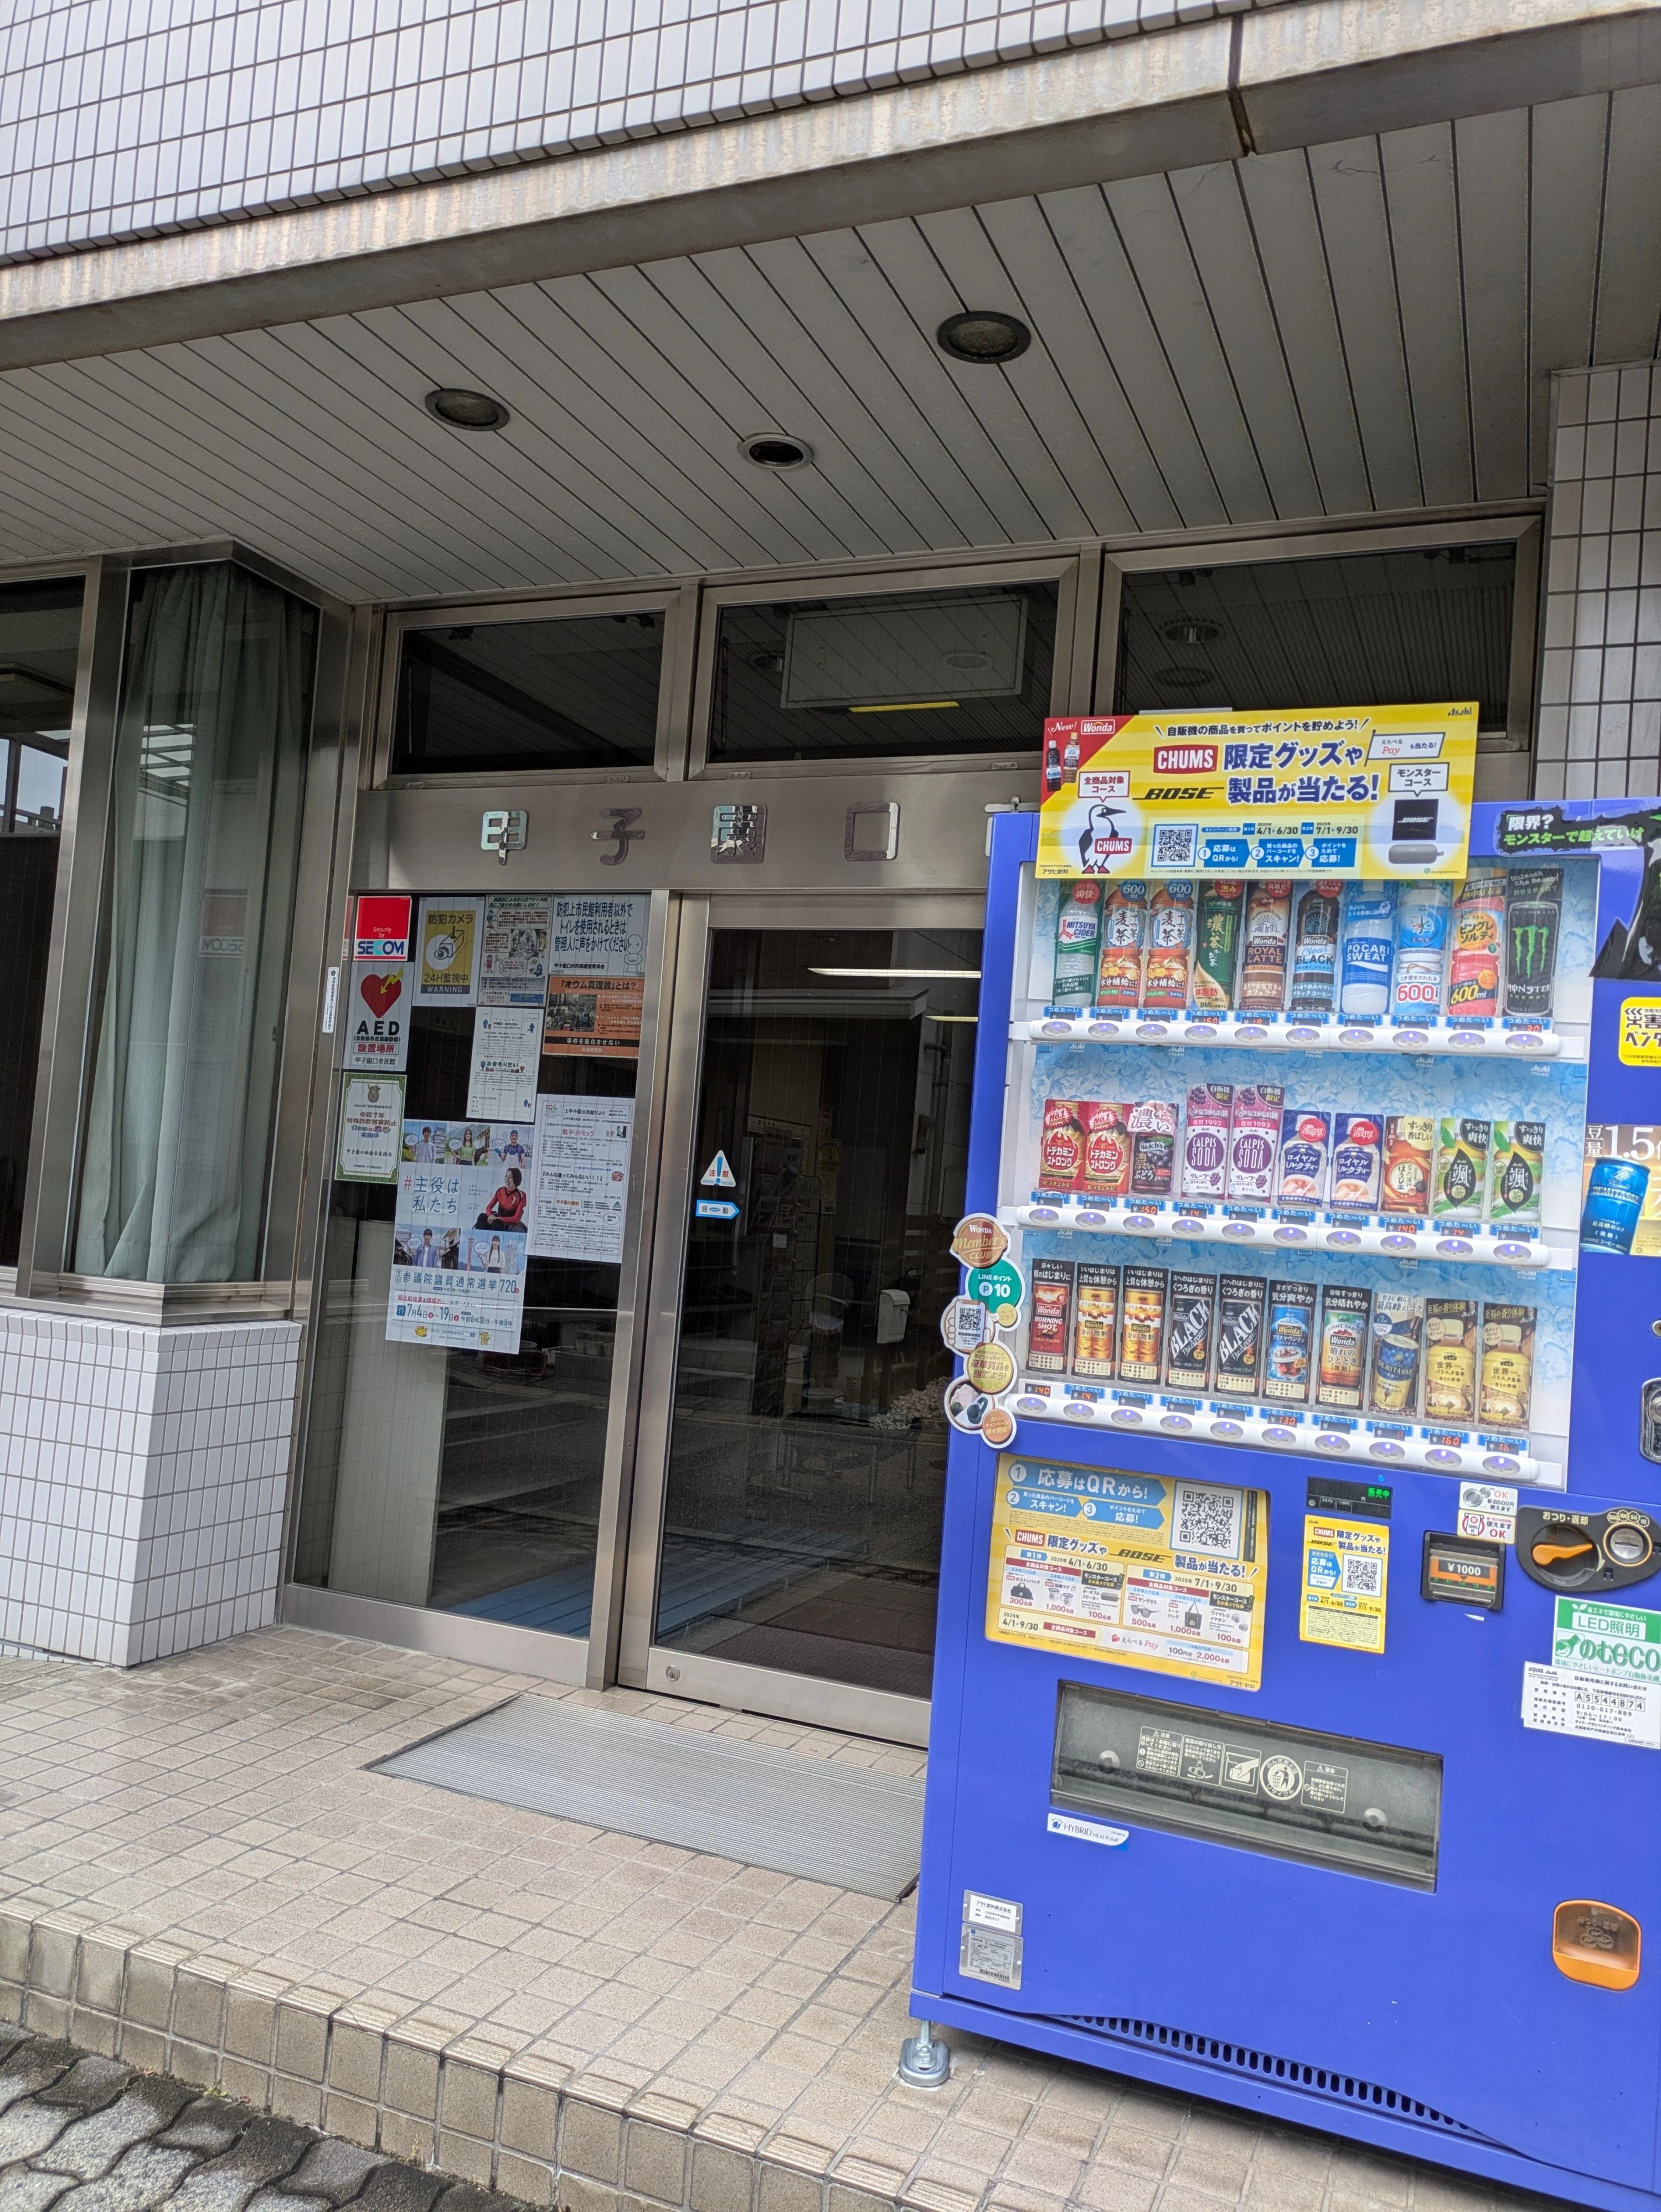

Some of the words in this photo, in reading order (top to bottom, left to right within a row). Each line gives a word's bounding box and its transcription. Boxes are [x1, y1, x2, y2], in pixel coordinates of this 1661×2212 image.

[1448, 707, 1472, 716] Asahi
[1168, 719, 1359, 737] 自販機の商品を買ってポイントを貯めよう!
[1158, 749, 1214, 769] CHUMS
[1224, 740, 1363, 770] 限定グッズや
[1382, 746, 1400, 755] Pay
[1084, 776, 1124, 785] 全商品対象
[1405, 778, 1431, 787] コース
[1133, 787, 1224, 800] BOSE
[1228, 775, 1379, 803] 製品が当たる!
[1508, 814, 1554, 831] 限界?
[1213, 844, 1236, 853] 応募は
[1510, 871, 1543, 881] Unleash
[1169, 884, 1190, 894] 600
[556, 902, 633, 917] 防犯上市民館利用者以外で
[428, 914, 473, 924] 防犯カメラ
[560, 920, 626, 935] トイレを使用されるときは
[1067, 921, 1096, 930] MITSUYA
[358, 940, 404, 955] SECOM
[555, 936, 629, 952] 管理人に声をかけてください
[1348, 944, 1389, 954] POCARI
[1247, 947, 1283, 956] ROYAL
[1302, 947, 1328, 956] Clear
[1247, 955, 1282, 963] LATTE
[1296, 956, 1334, 964] BLACK
[1347, 953, 1386, 962] SWEAT
[424, 973, 468, 983] 24H監視中
[1147, 978, 1184, 988] 水分補給に!
[561, 981, 636, 990] 「オウム真理教」とは?
[1398, 984, 1434, 1002] 600
[357, 1020, 400, 1035] AED
[358, 1044, 395, 1053] 設置場所
[1260, 1086, 1281, 1095] 自販機
[1465, 1122, 1488, 1132] すっきり
[1519, 1125, 1543, 1135] すっきり
[1407, 1132, 1432, 1141] 香ばしい
[1141, 1142, 1163, 1151] Welch's
[1240, 1138, 1265, 1149] CALPIS
[1047, 1146, 1074, 1156] ドデカミン
[1091, 1151, 1118, 1161] ドデカミン
[1047, 1157, 1072, 1167] ストロング
[1238, 1149, 1263, 1169] SODA
[1091, 1161, 1116, 1171] ストロング
[1338, 1166, 1370, 1174] ミルクティー
[1134, 1170, 1153, 1180] ぶどう
[1592, 1186, 1639, 1205] DEMITASSE
[412, 1195, 456, 1213] 私たち
[969, 1225, 992, 1234] WONDA
[953, 1235, 1005, 1249] Member's
[1127, 1269, 1163, 1277] いいはじまりは
[403, 1271, 497, 1291] 参議院議員通常選挙
[1222, 1279, 1264, 1288] 次へのはじまりに
[994, 1284, 1010, 1297] 10
[1276, 1284, 1309, 1293] 甘さすっきり
[1272, 1293, 1313, 1303] 気分爽やか
[1330, 1290, 1363, 1298] 後味すっきり
[1034, 1316, 1062, 1325] MORNING
[1278, 1325, 1301, 1335] Wonda
[1273, 1334, 1305, 1343] アイスマウンテン
[1331, 1336, 1355, 1346] Wonda
[1327, 1355, 1357, 1365] ひととき
[1493, 1367, 1521, 1377] 世界一の
[1038, 1467, 1148, 1499] 応募はQRから!
[1368, 1487, 1390, 1499] 販売中
[1494, 1490, 1508, 1498] OK
[1543, 1512, 1588, 1525] おつり・返却
[1487, 1520, 1512, 1529] 使えます
[1489, 1529, 1506, 1539] OK
[1087, 1561, 1108, 1571] 6/30
[1311, 1565, 1336, 1576] QRから!
[1447, 1562, 1481, 1576] ¥1000
[1148, 1582, 1187, 1592] 全商品対象コース
[1195, 1578, 1210, 1588] 7/1
[1215, 1581, 1237, 1592] 9/30
[1009, 1597, 1033, 1607] 300名様
[1212, 1594, 1247, 1604] モンスターコース
[1587, 1607, 1647, 1621] 省エネで環境にやさしい
[1003, 1618, 1015, 1627] 4/1
[1131, 1618, 1156, 1628] 500名様
[1578, 1615, 1640, 1638] LED照明
[1170, 1626, 1201, 1636] 1,000名様
[1217, 1633, 1241, 1644] 100名様
[1144, 1640, 1159, 1650] Pay
[1169, 1647, 1192, 1657] 100円分
[1196, 1652, 1230, 1664] 2,000名様
[1554, 1658, 1659, 1682] 環境にやさしいヒートポンプ自動販売機
[1064, 1823, 1092, 1836] HYBRID
